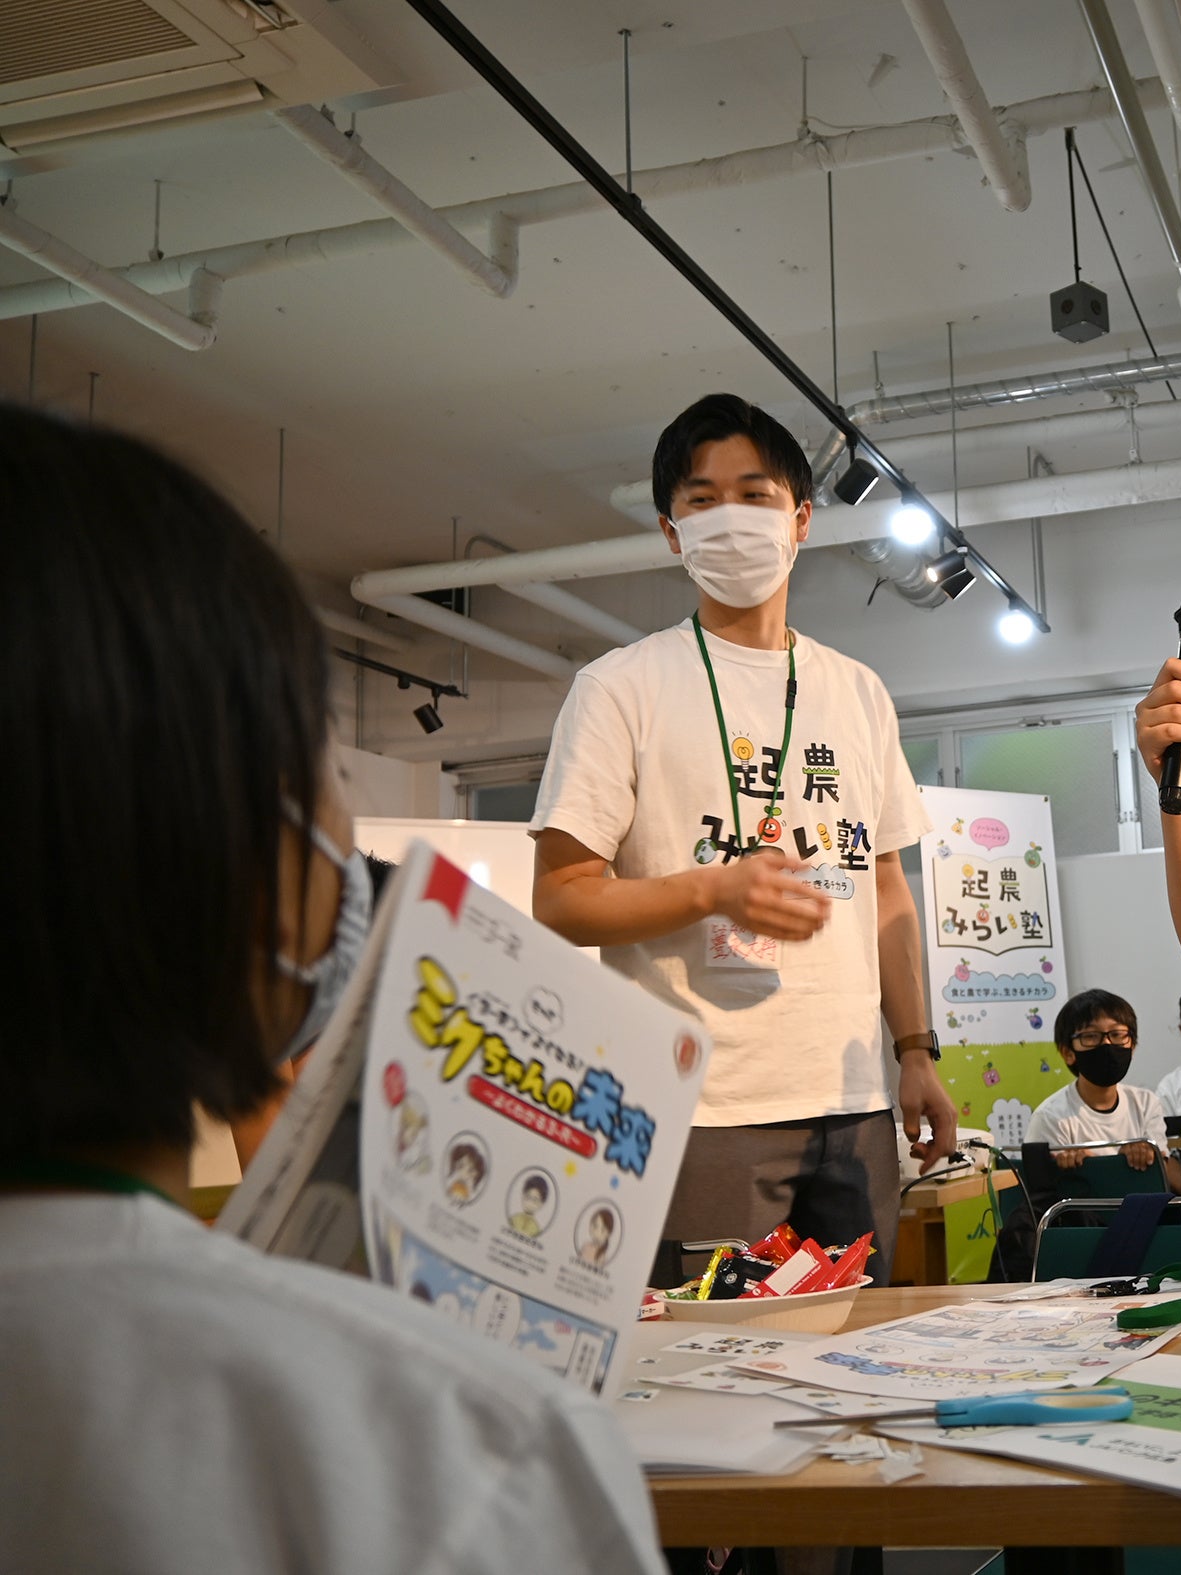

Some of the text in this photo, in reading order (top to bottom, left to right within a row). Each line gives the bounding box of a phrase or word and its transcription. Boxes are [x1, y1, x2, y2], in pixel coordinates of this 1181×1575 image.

[732, 736, 841, 803] 起農
[961, 863, 1021, 902] 起農
[942, 903, 1043, 942] みらい塾
[951, 986, 1048, 998] 食と農で学ぶ、生きるチカラ
[408, 955, 657, 1178] ミクちゃんの未来
